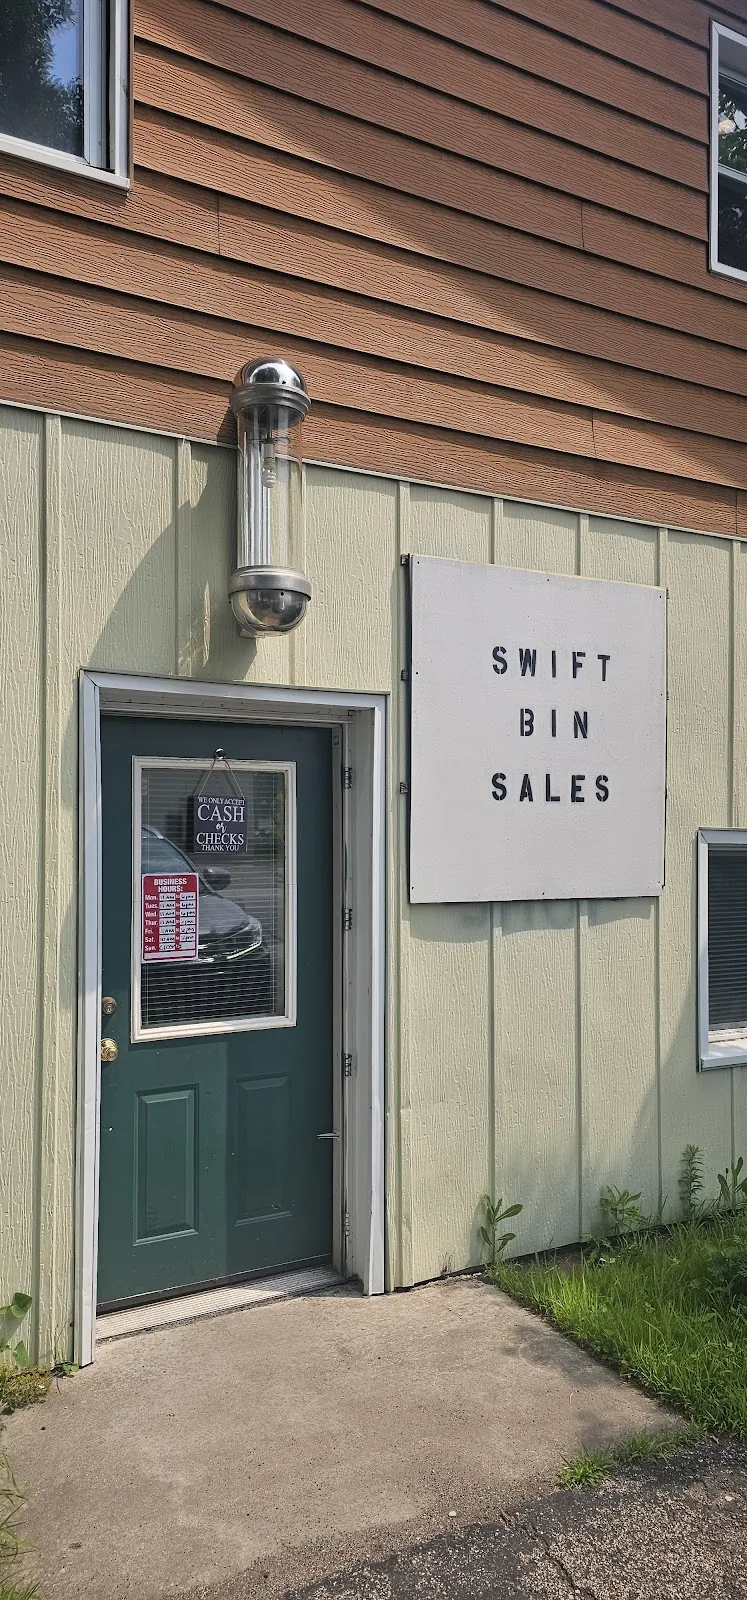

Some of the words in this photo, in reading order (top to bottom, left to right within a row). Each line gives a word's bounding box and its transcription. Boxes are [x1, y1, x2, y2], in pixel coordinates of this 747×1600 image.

[492, 646, 611, 682] SWIFT
[519, 708, 588, 739] BIN
[491, 772, 610, 803] SALES
[197, 804, 245, 822] CASH
[215, 822, 227, 833] or
[196, 832, 244, 845] CHECKS
[158, 885, 183, 893] HOURS:
